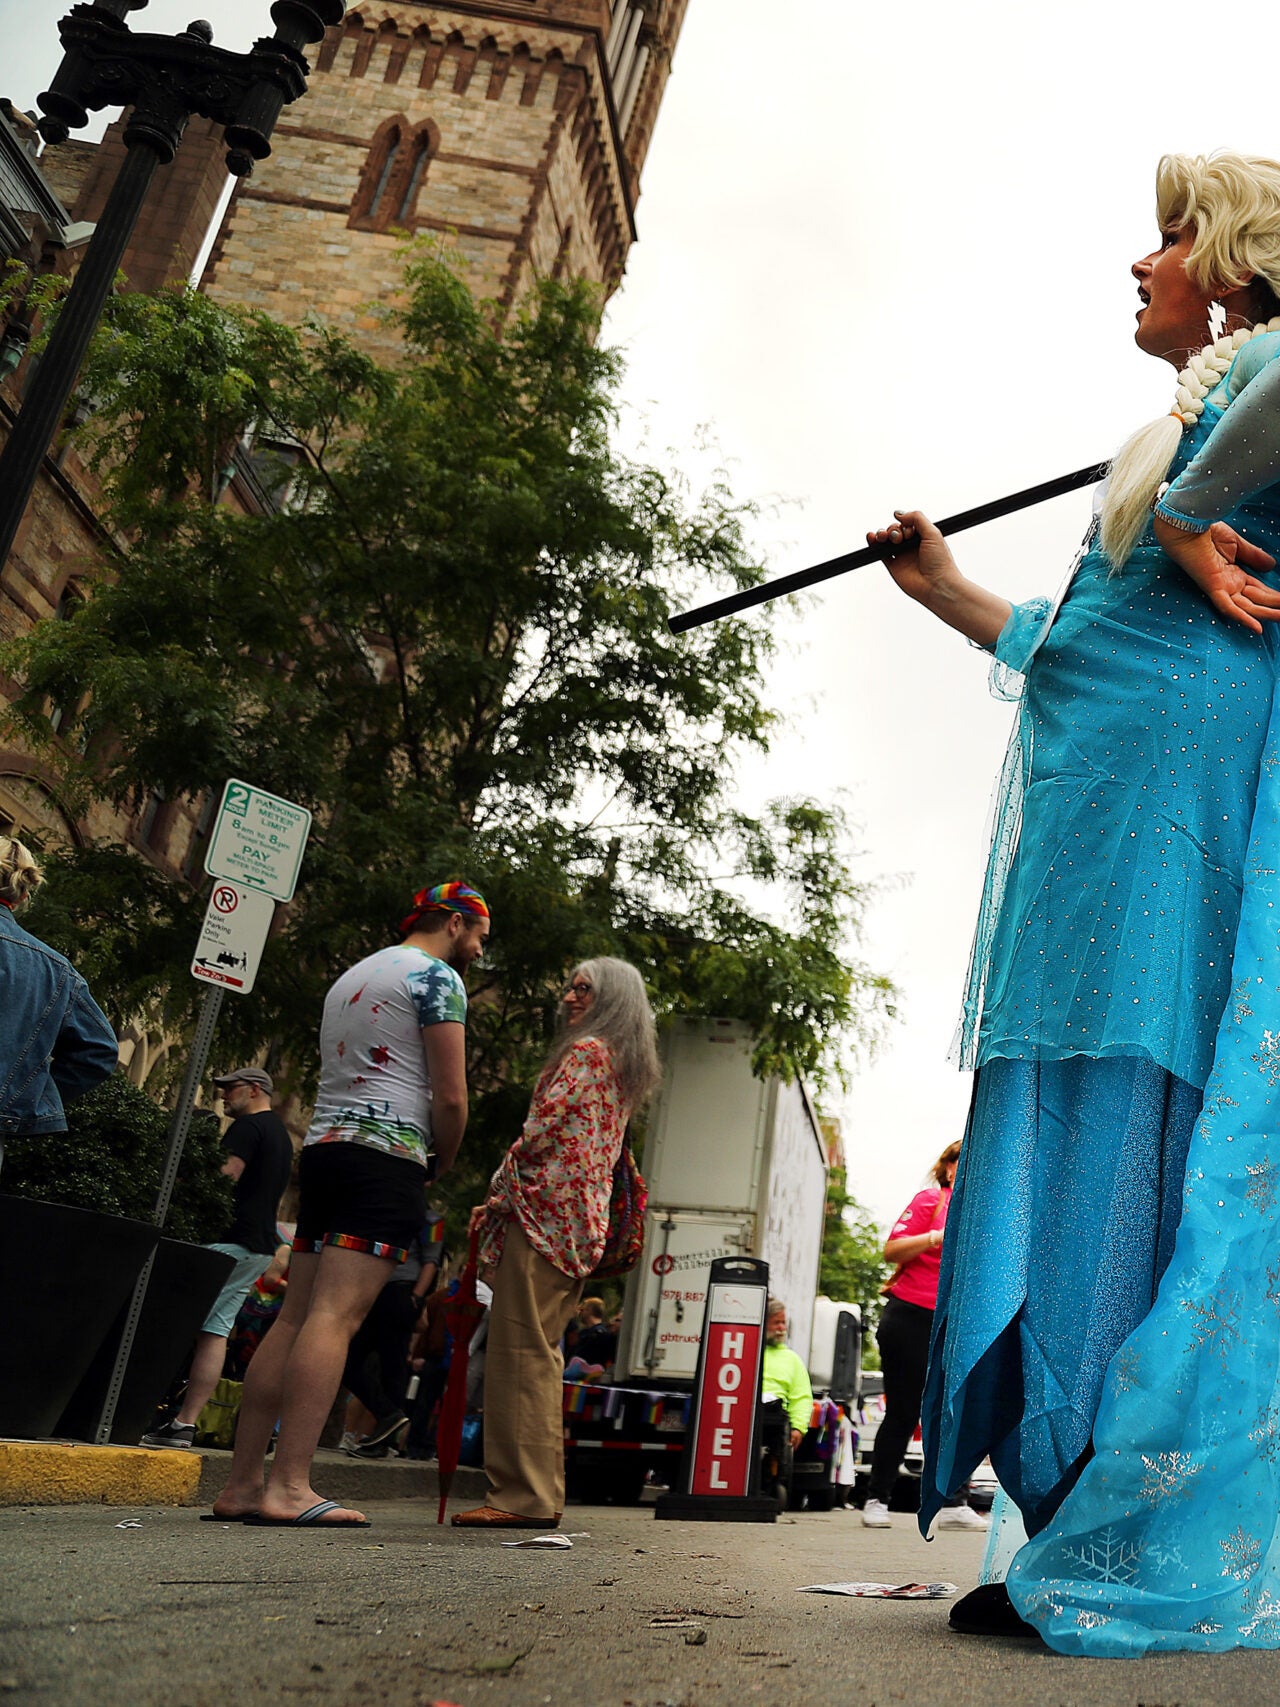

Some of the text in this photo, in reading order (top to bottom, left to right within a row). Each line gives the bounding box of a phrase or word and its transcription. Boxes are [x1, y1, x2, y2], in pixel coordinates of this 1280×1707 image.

[229, 786, 249, 808] 2
[255, 798, 301, 821] PARKING
[259, 808, 294, 827] METER
[261, 819, 288, 833] LIMIT
[242, 845, 271, 862] PAY
[204, 928, 220, 939] Only
[206, 920, 232, 935] Parking
[709, 1331, 745, 1490] HOTEL
